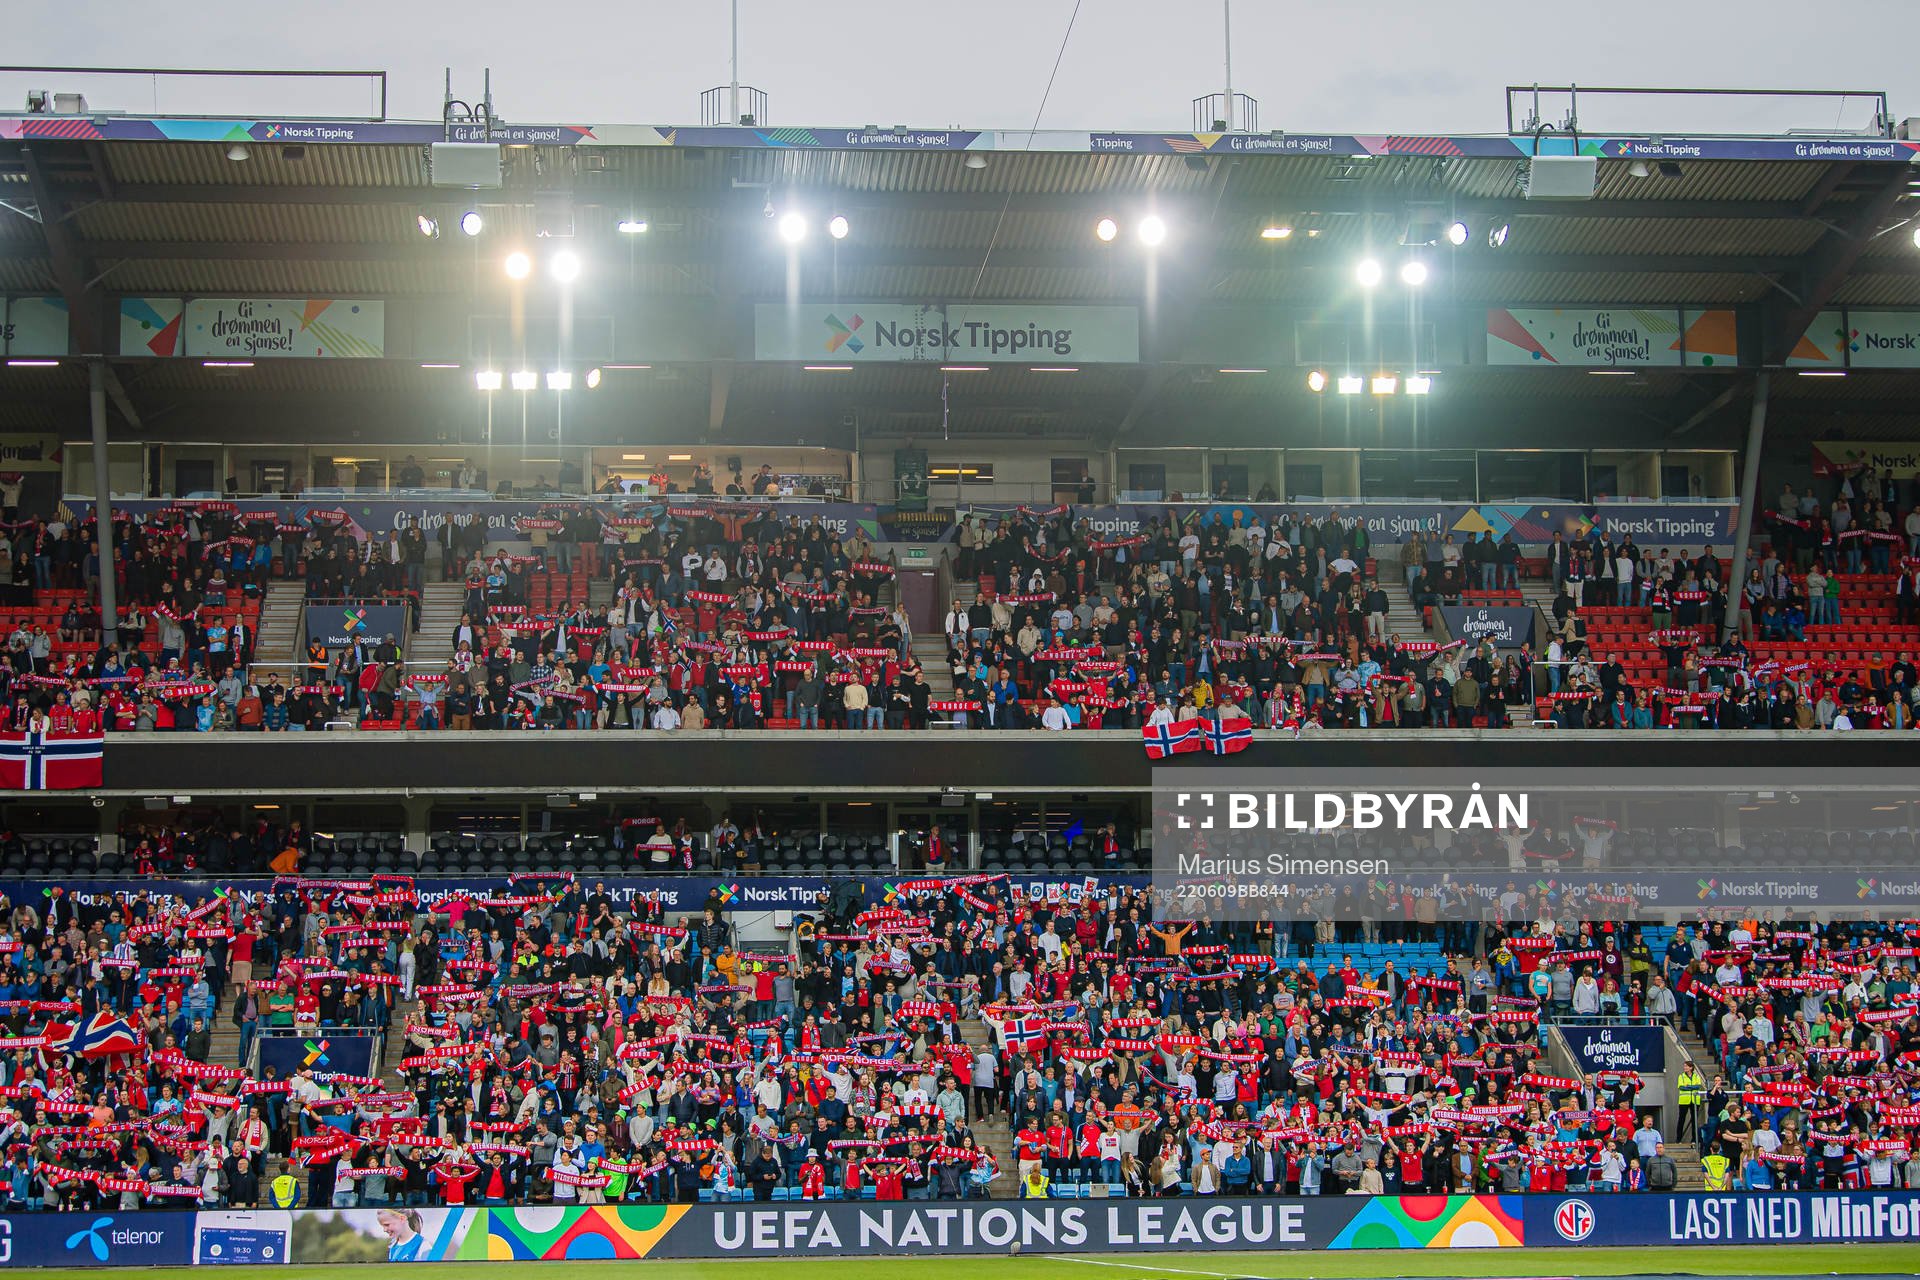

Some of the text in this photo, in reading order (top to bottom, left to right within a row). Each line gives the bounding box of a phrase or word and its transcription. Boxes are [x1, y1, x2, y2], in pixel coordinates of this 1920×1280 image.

[284, 127, 354, 142] Norsk Tipping
[455, 127, 560, 143] Gi en sjanse!
[846, 132, 857, 144] Gi
[903, 135, 914, 144] en
[917, 133, 950, 148] sjanse!
[1096, 138, 1134, 150] Tipping
[1231, 137, 1242, 150] Gi
[1287, 140, 1298, 149] en
[1300, 138, 1332, 152] sjanse!
[1634, 144, 1701, 156] Norsk Tipping
[1795, 143, 1807, 156] Gi
[1849, 148, 1861, 156] en
[1863, 144, 1894, 158] sjanse!
[238, 301, 253, 319] Gi
[211, 310, 282, 338] drømmen
[1596, 312, 1610, 330] Gi
[875, 321, 1072, 355] Norsk Tipping
[1573, 321, 1638, 349] drømmen
[1866, 333, 1916, 349] Norsk
[226, 328, 293, 356] en sjanse!
[1587, 338, 1649, 367] en sjanse!
[1872, 453, 1917, 468] Norsk
[487, 513, 506, 528] en
[1368, 516, 1386, 532] en
[1606, 517, 1716, 537] Norsk Tipping
[1479, 610, 1488, 621] Gi
[1463, 616, 1505, 632] drømmen
[328, 636, 351, 645] Norsk
[1785, 662, 1809, 672] NORGE
[744, 886, 789, 901] Norsk
[1721, 881, 1819, 899] Norsk Tipping
[1241, 954, 1268, 963] NORGE
[1792, 979, 1811, 987] NORGE
[444, 992, 482, 1002] NORWAY
[1118, 1018, 1146, 1027] NORGE
[1501, 1013, 1529, 1021] NORGE
[1865, 1012, 1888, 1021] STERKERE
[1168, 1036, 1196, 1044] NORGE
[1601, 1029, 1612, 1041] Gi
[1121, 1041, 1148, 1049] NORGE
[1584, 1036, 1631, 1057] drømmen
[1073, 1049, 1102, 1058] NORGE
[1388, 1051, 1416, 1060] NORGE
[1593, 1048, 1639, 1069] en sjanse!
[854, 1058, 893, 1066] NORGE
[1537, 1077, 1566, 1088] NORGE
[1755, 1096, 1781, 1104] NORGE
[1472, 1106, 1498, 1115] STERKERE
[1395, 1126, 1422, 1135] NORGE
[299, 1137, 335, 1145] NORGE
[406, 1136, 437, 1144] NORGE
[1885, 1141, 1904, 1150] ELSKER
[942, 1148, 971, 1158] NORGE
[1766, 1153, 1801, 1163] NORWAY
[601, 1160, 627, 1171] STERKERE
[353, 1168, 390, 1176] NORWAY
[554, 1171, 607, 1185] STERKERE SAMMEN
[1669, 1198, 1736, 1240] LAST
[1747, 1197, 1802, 1239] NED
[714, 1206, 1305, 1249] UEFA NATIONS LEAGUE
[111, 1227, 164, 1244] telenor
